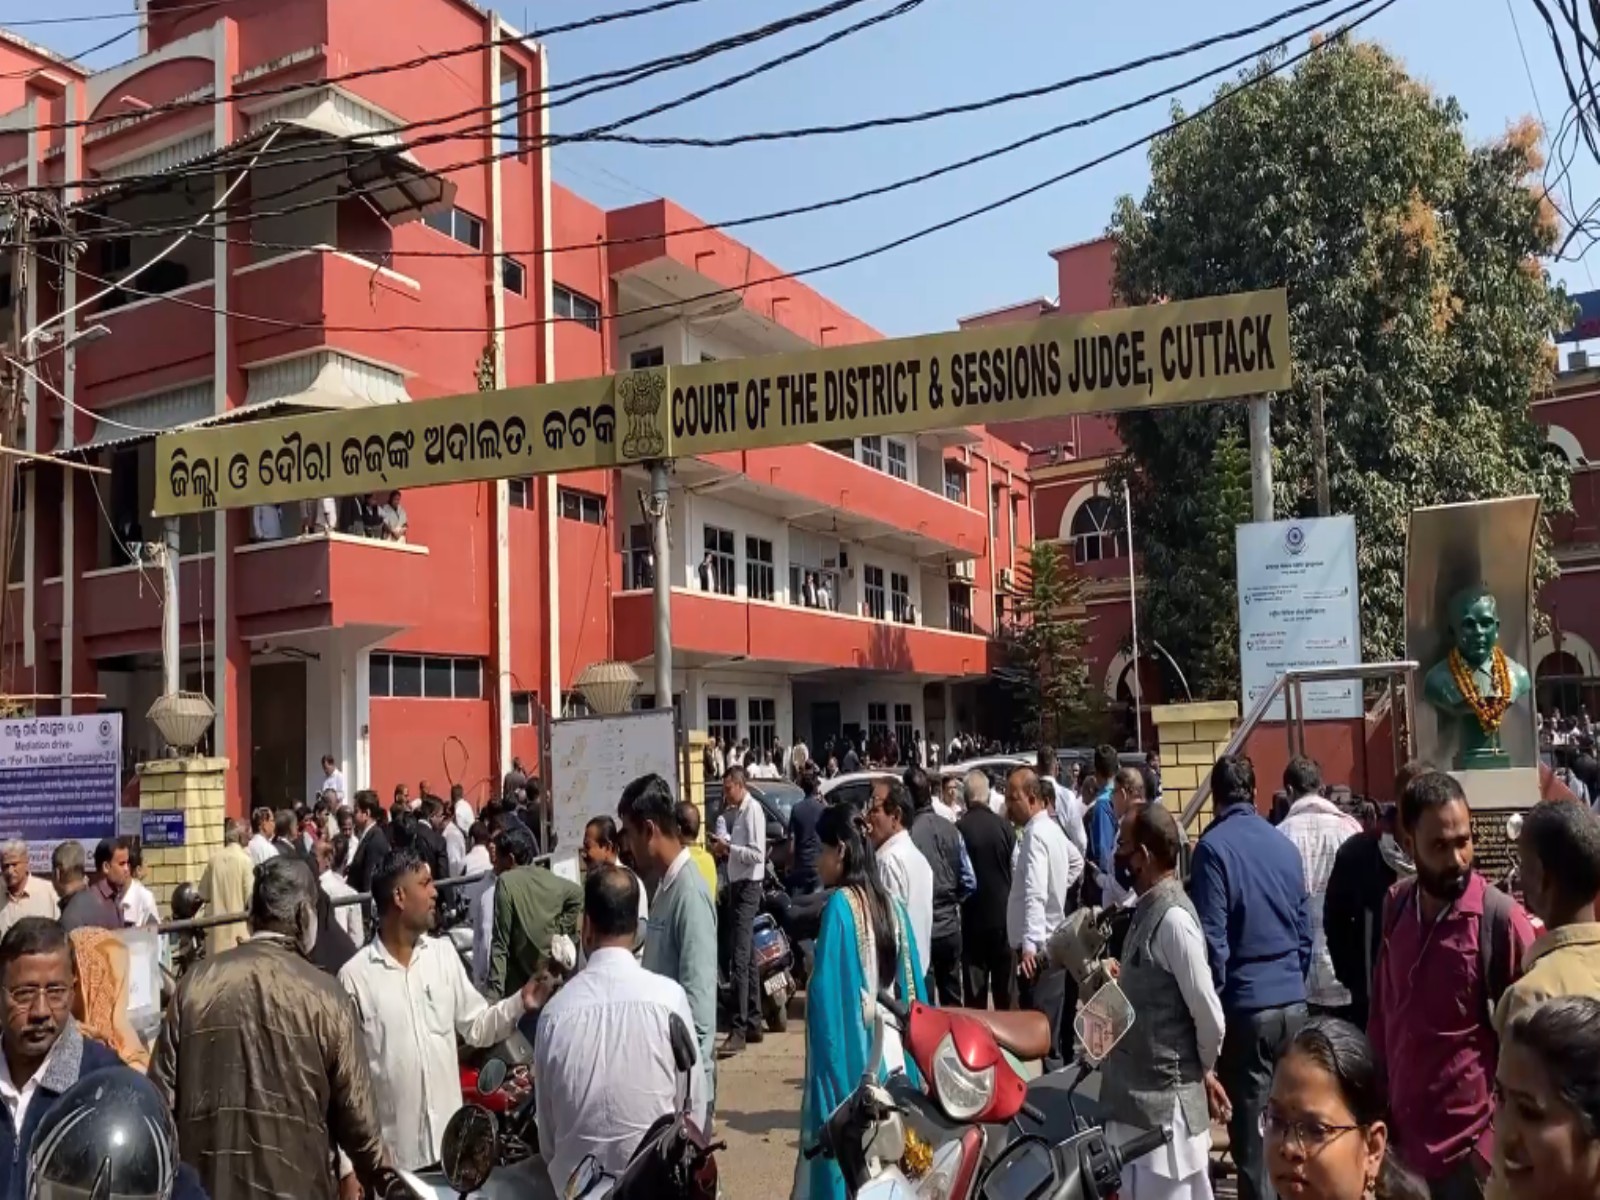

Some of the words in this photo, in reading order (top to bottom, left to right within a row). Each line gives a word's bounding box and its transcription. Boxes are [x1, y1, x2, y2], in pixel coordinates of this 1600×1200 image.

[672, 382, 739, 440] COURT
[745, 378, 773, 432] OF
[777, 373, 820, 428] THE
[824, 360, 922, 422] DISTRICT
[929, 357, 946, 411] &
[951, 341, 1063, 409] SESSIONS
[1068, 331, 1155, 396] JUDGE,
[1160, 314, 1276, 383] CUTTACK
[170, 447, 218, 508] ଜିଲ୍ଲା
[228, 453, 250, 490] ଓ
[258, 431, 331, 484] ଦୌରା
[424, 415, 533, 465] ଅଦାଲତ,
[543, 404, 616, 450] କଟକ
[15, 741, 51, 752] Mediation
